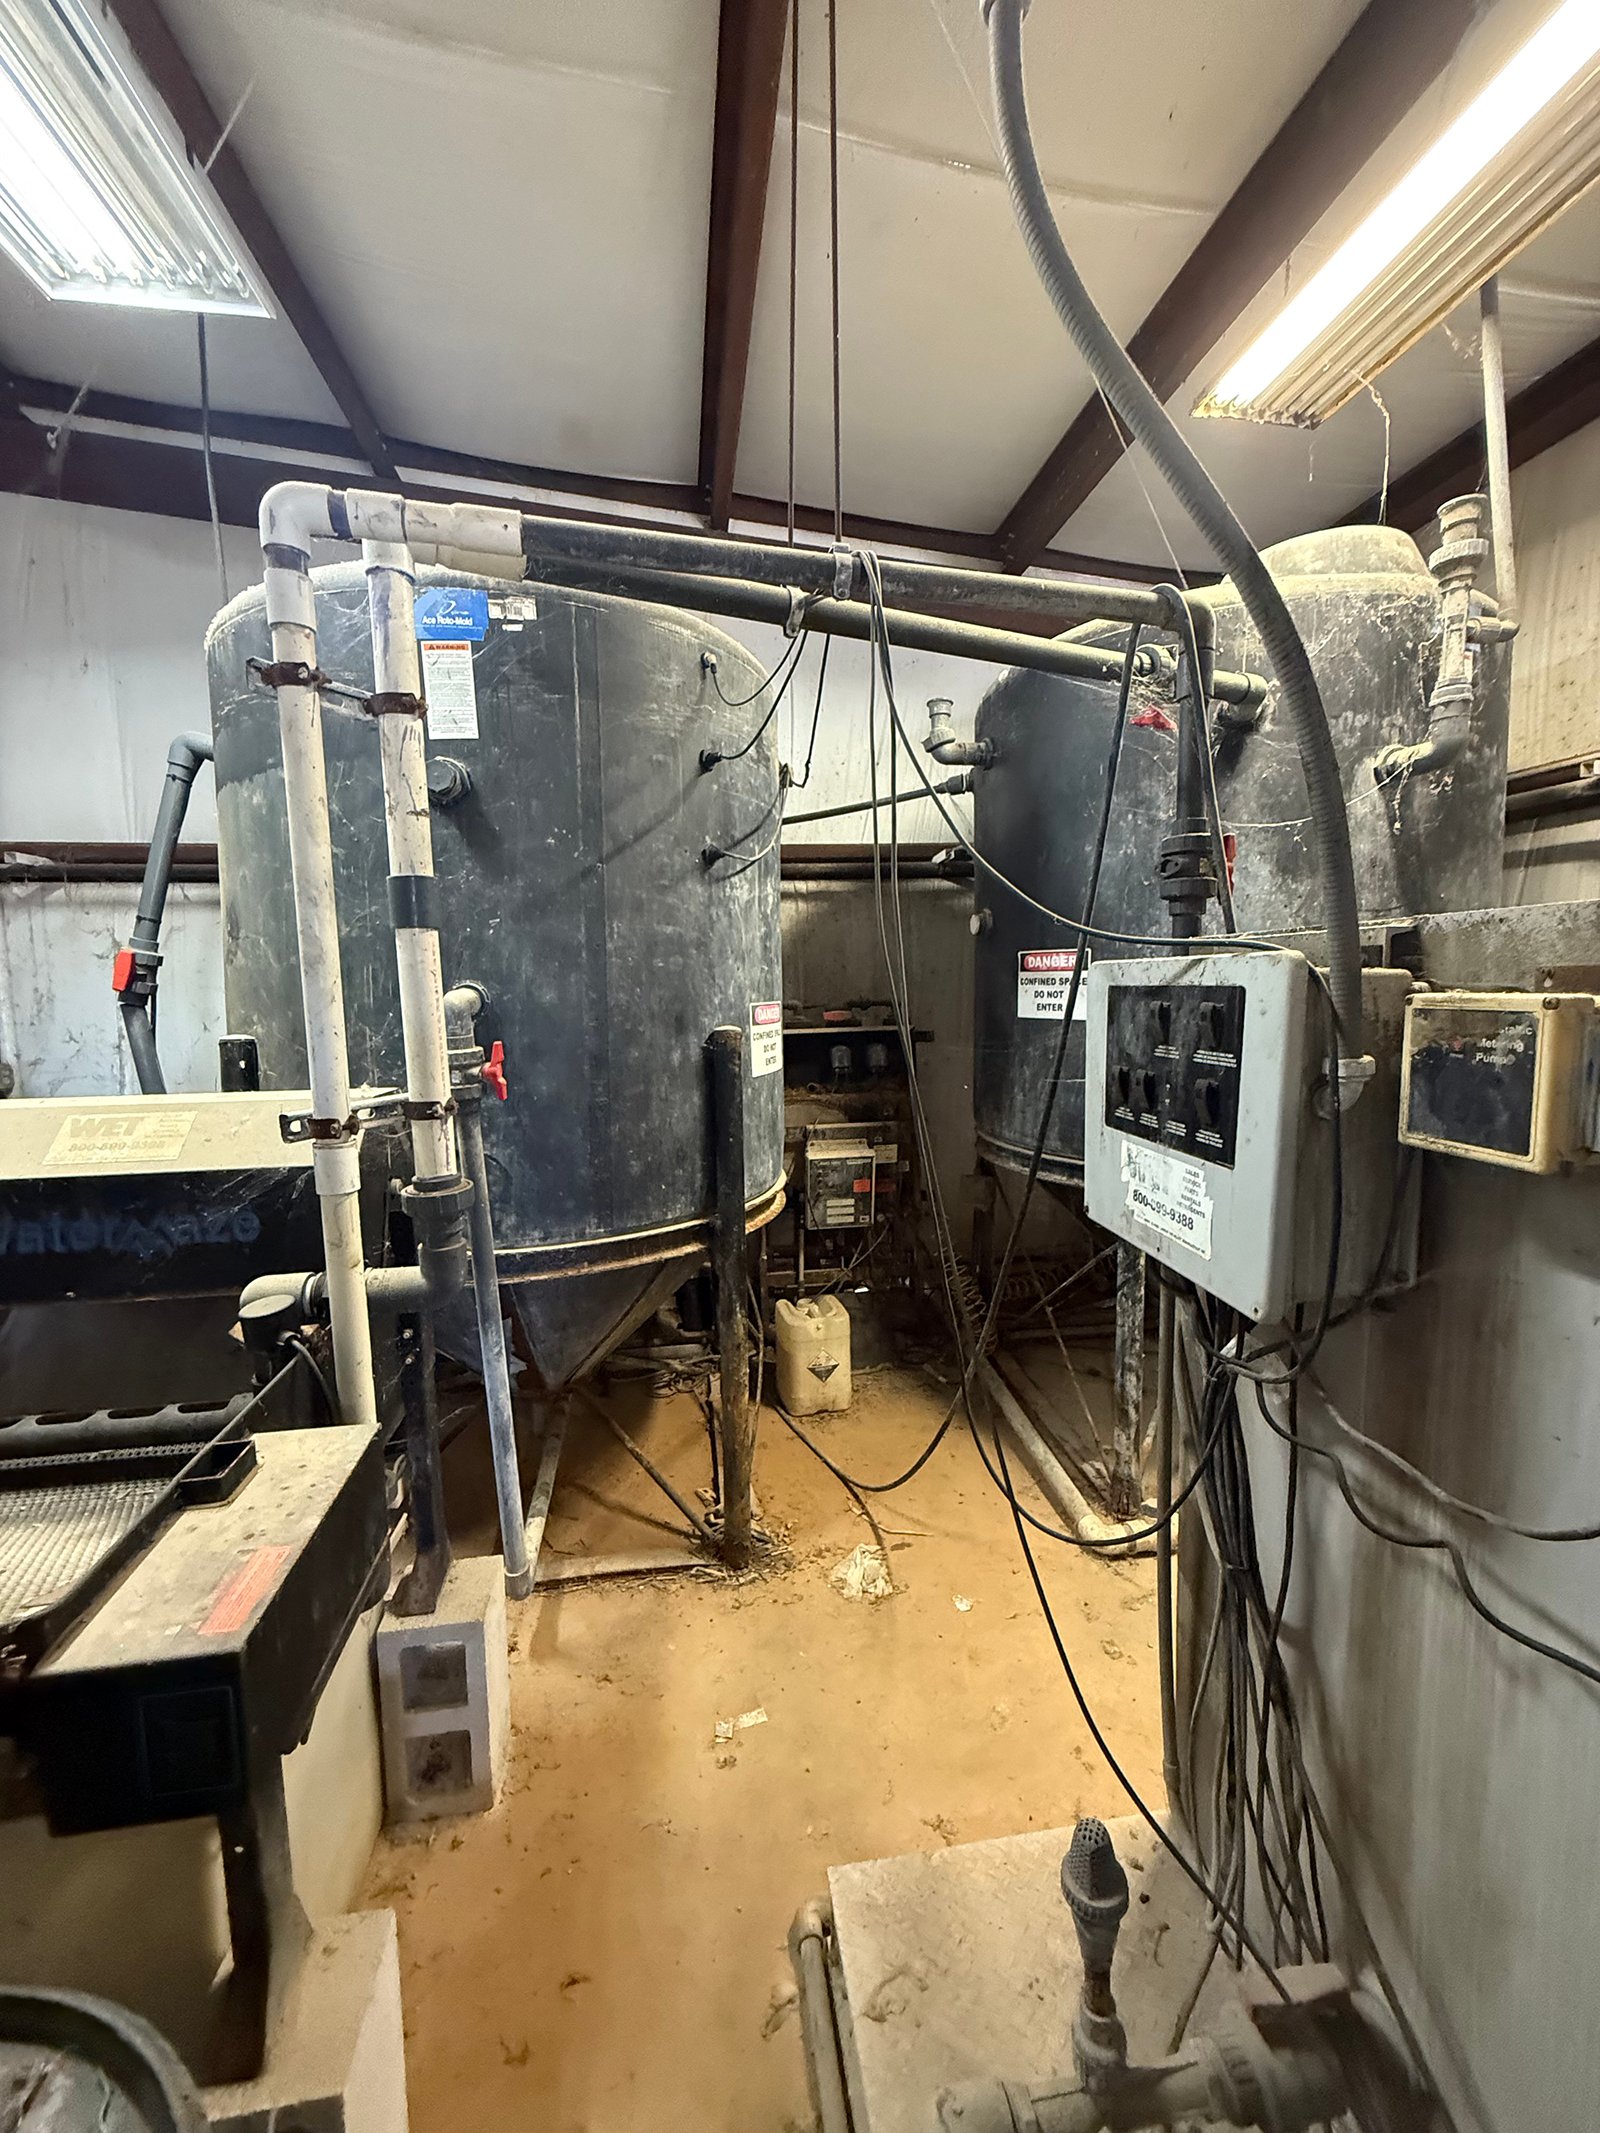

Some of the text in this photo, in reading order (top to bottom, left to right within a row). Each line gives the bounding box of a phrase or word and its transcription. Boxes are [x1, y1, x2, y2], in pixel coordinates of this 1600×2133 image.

[422, 615, 473, 625] Ace Roto-Mold
[1028, 955, 1076, 968] DANGER
[1020, 977, 1087, 986] CONFINED SPE
[1034, 990, 1064, 998] DO NOT
[1036, 1003, 1063, 1011] ENTER
[70, 1117, 146, 1138] WET
